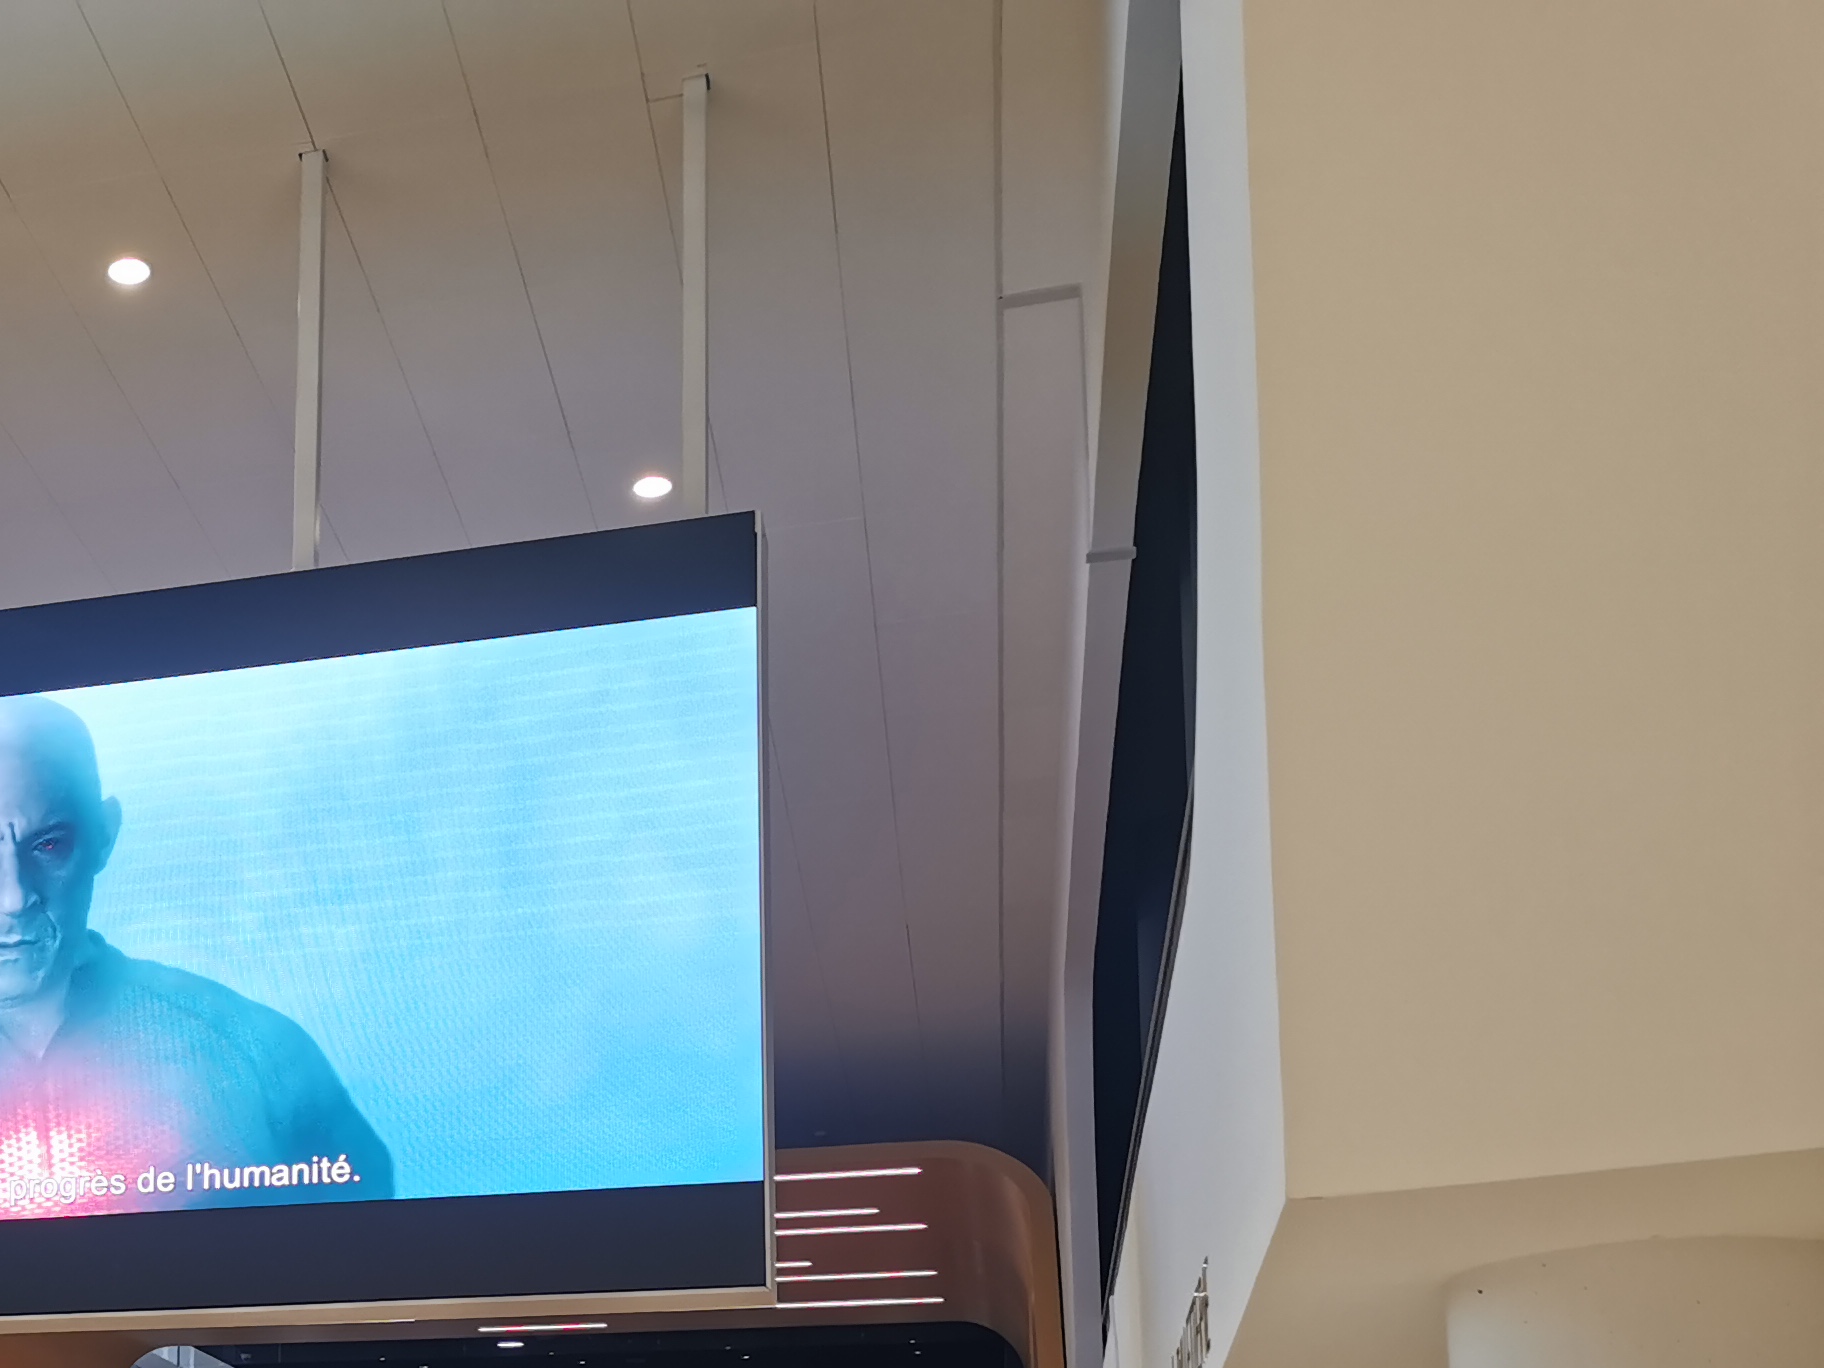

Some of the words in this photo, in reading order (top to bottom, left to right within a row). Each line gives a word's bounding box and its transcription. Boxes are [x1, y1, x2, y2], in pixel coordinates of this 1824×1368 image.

[8, 1170, 125, 1203] progrès
[136, 1165, 176, 1193] de
[186, 1154, 361, 1191] l'humanité.
